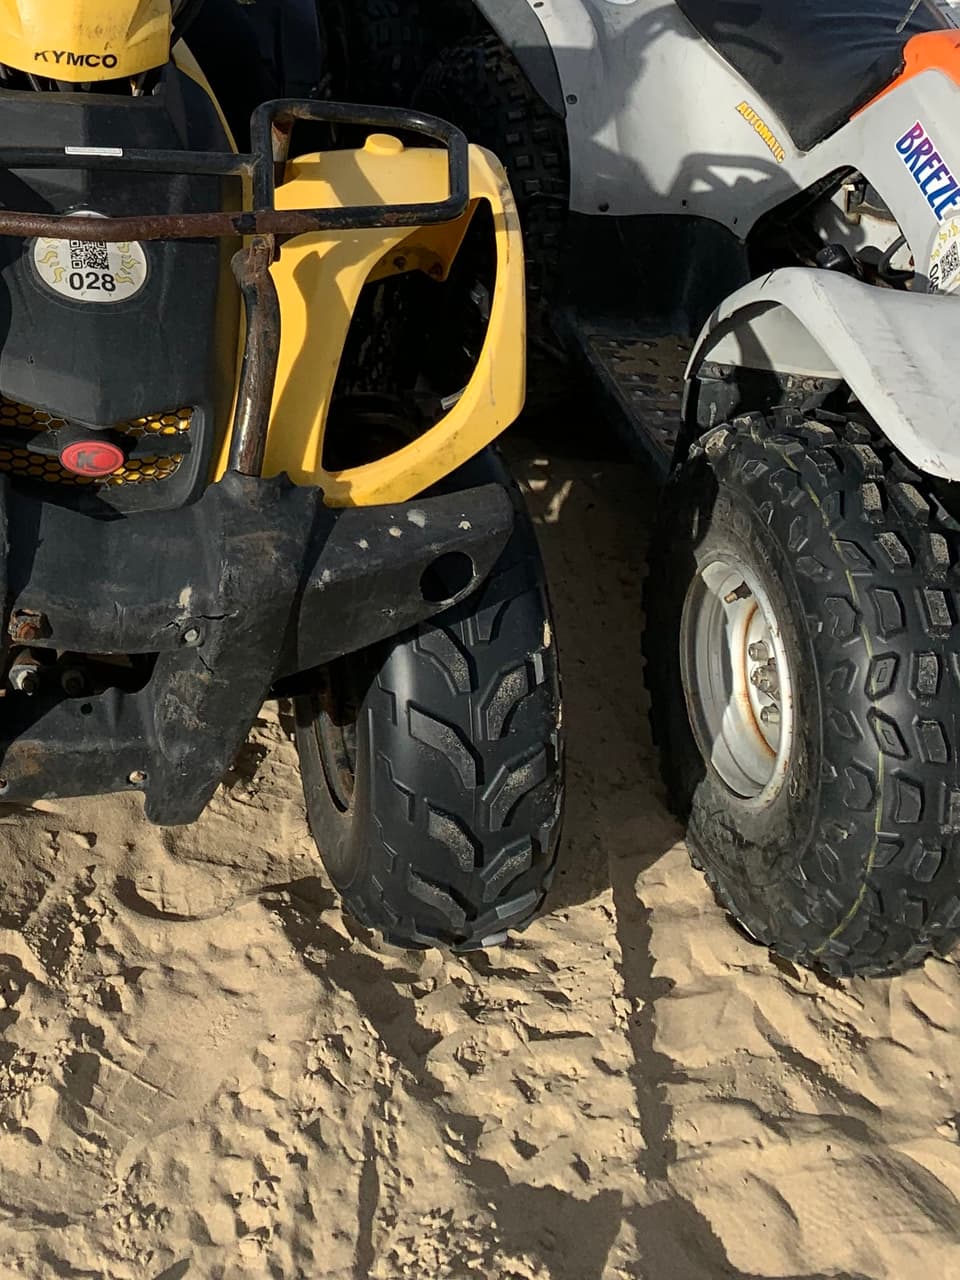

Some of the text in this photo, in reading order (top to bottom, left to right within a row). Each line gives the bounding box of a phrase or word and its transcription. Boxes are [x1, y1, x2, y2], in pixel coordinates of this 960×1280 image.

[735, 100, 785, 163] AUTOMATIC
[896, 121, 960, 221] BREEZE
[69, 272, 116, 292] 028
